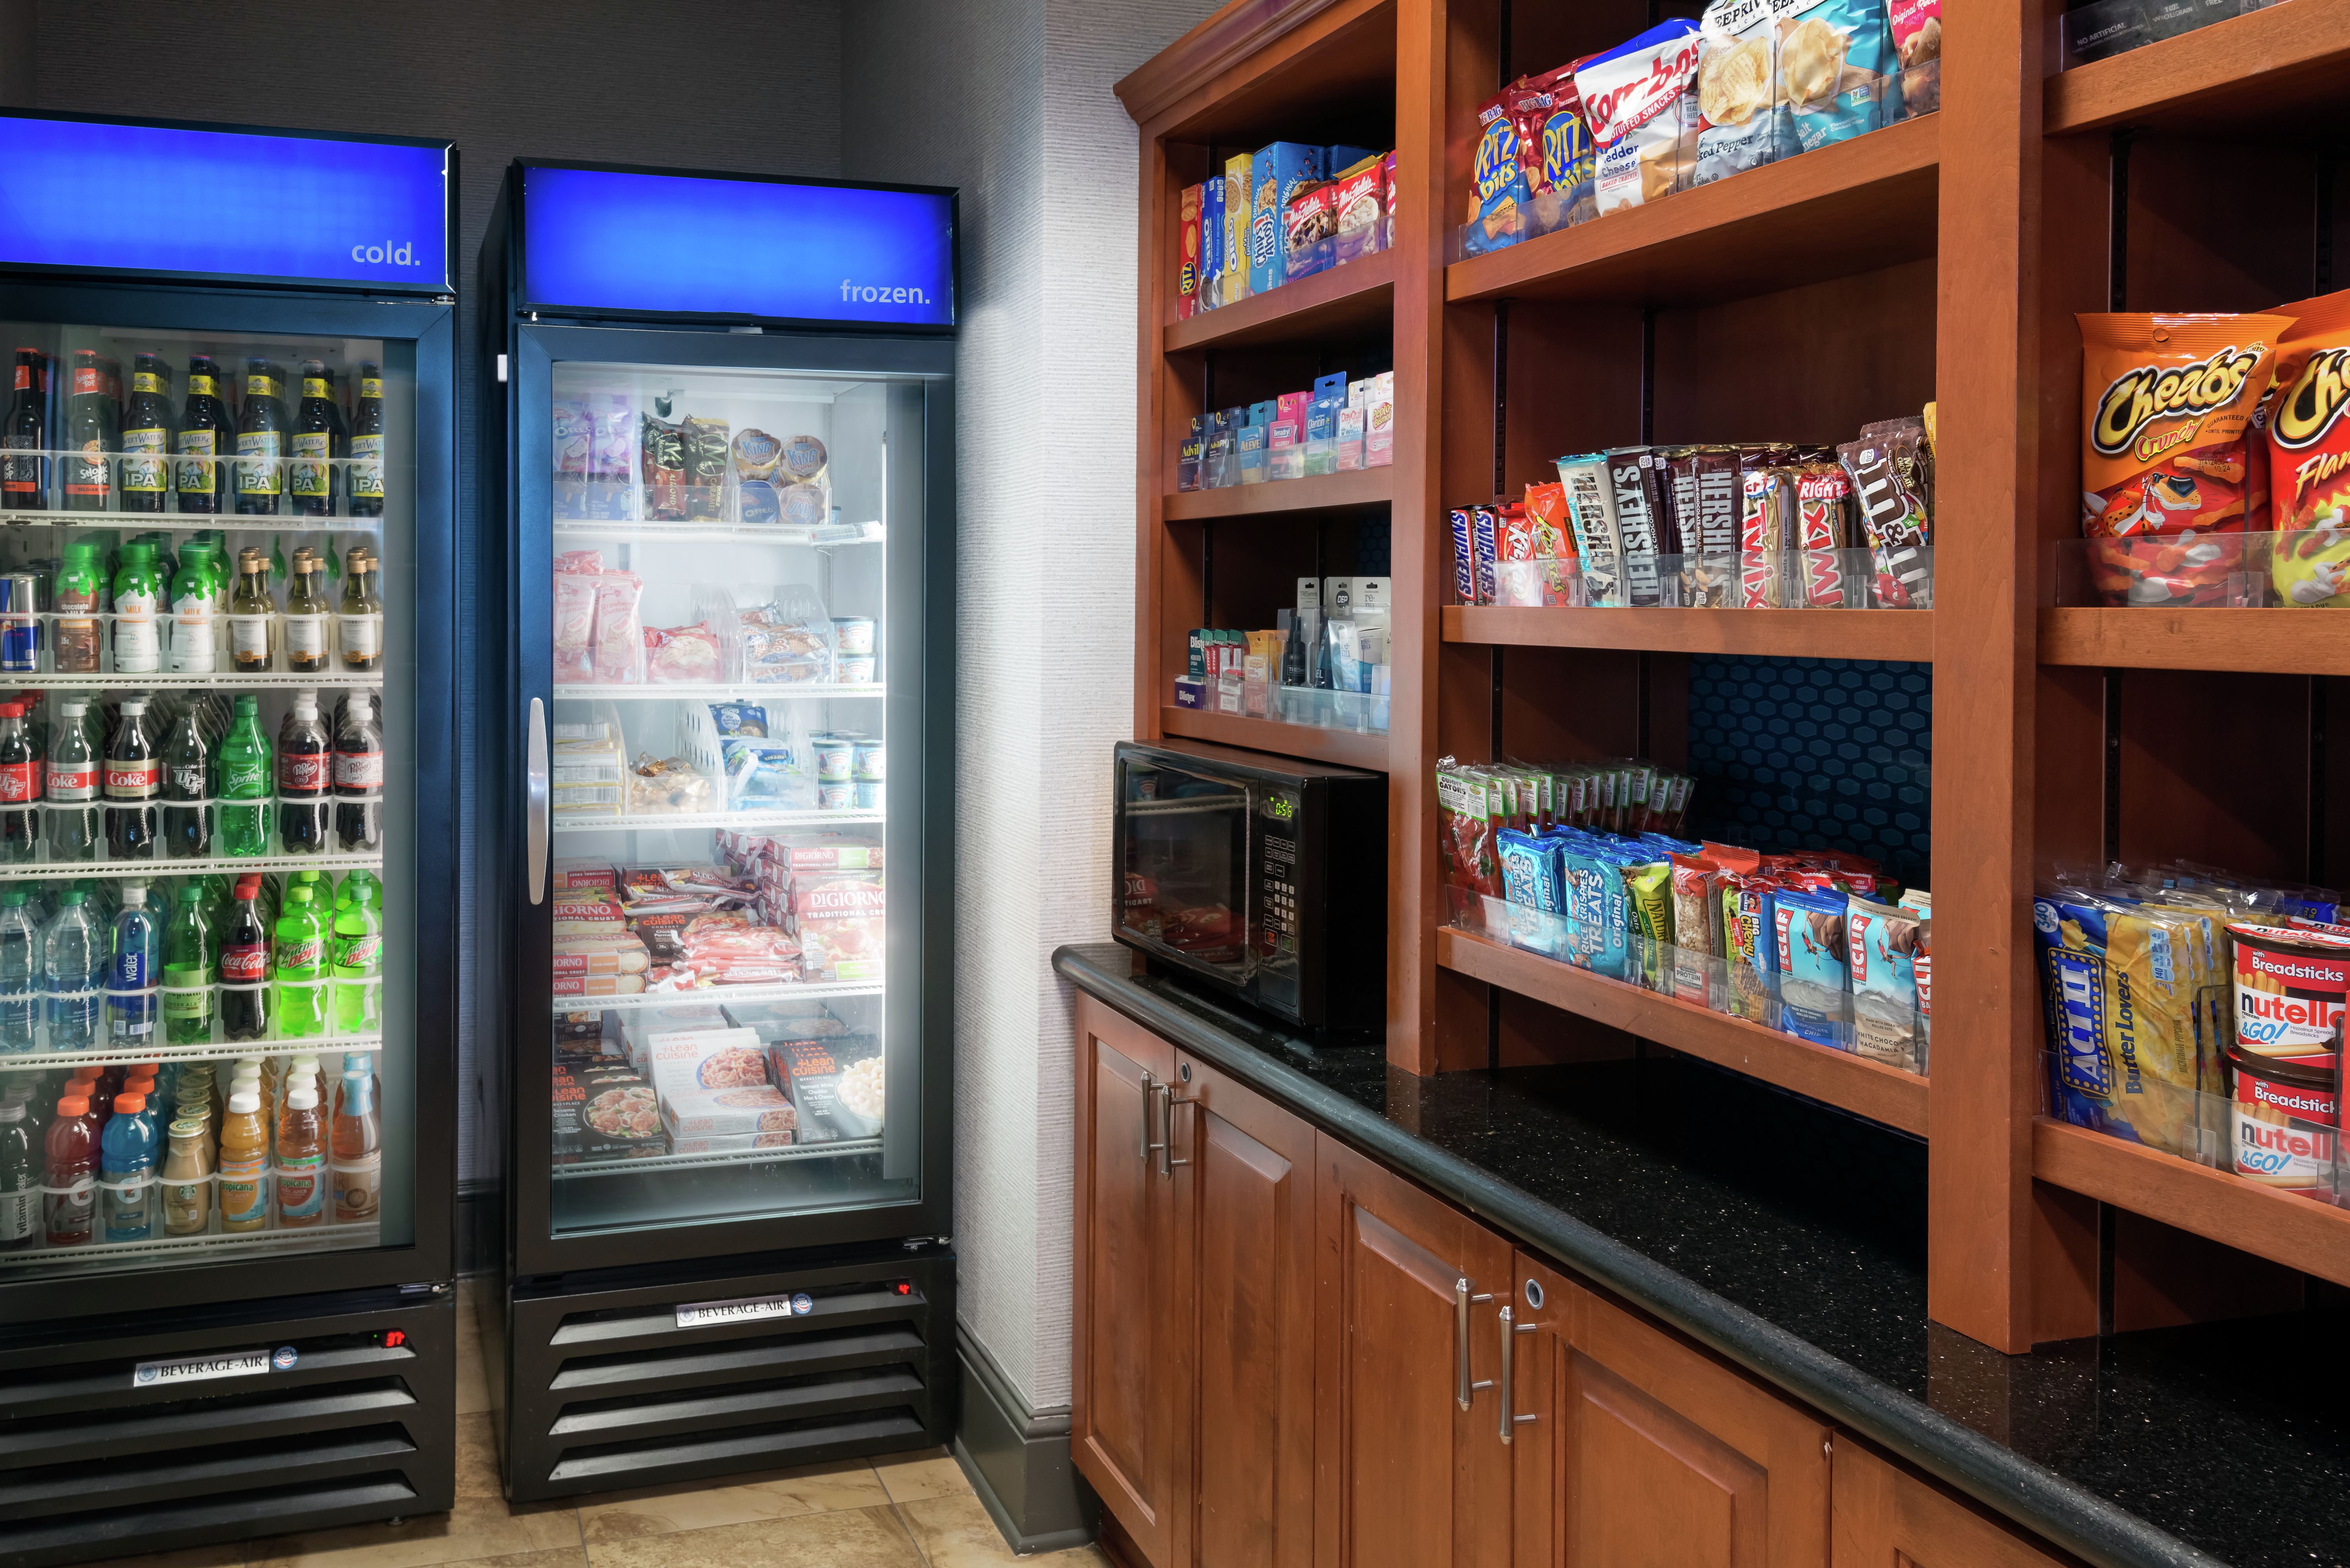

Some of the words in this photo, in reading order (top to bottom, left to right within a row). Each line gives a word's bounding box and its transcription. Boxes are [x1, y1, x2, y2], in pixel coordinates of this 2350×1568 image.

[1892, 3, 1916, 25] Original
[2165, 3, 2179, 12] 100%
[2077, 38, 2088, 46] NO
[2090, 22, 2127, 41] ARTIFICIAL
[1519, 98, 1536, 112] BIG
[1535, 93, 1553, 108] BAG
[1612, 115, 1640, 138] STUFFED
[1642, 89, 1676, 120] SNACKS
[1544, 117, 1592, 183] RITZ
[1716, 134, 1753, 154] Pepper
[1475, 124, 1519, 183] RITZ
[1602, 159, 1637, 178] Cheese
[1602, 179, 1617, 189] BAKED
[1619, 172, 1638, 185] CRACKER
[1252, 184, 1263, 218] ORIGINAL
[1229, 218, 1238, 271] OREO
[352, 241, 420, 266] cold.
[1181, 263, 1194, 293] RITZ
[840, 279, 930, 304] frozen.
[76, 373, 96, 383] SHOCK
[82, 379, 96, 387] TOP
[2094, 347, 2260, 451] Cheetos
[1308, 417, 1325, 430] Claritin
[1341, 408, 1362, 424] DayQuil
[1374, 412, 1392, 428] Bismol
[2207, 415, 2244, 428] GUARANTEED
[554, 426, 592, 437] OREO
[1273, 427, 1290, 438] Benadryl
[1240, 439, 1260, 452] ALEVE
[2135, 418, 2204, 461] Crunchy
[741, 441, 772, 456] KING
[1182, 443, 1199, 457] Advil
[786, 448, 817, 468] KING
[80, 465, 108, 479] SHOCK
[794, 463, 813, 472] Cone
[91, 474, 108, 485] TOP
[125, 473, 157, 487] IPA
[240, 476, 271, 490] IPA
[353, 479, 384, 493] IPA
[1815, 474, 1837, 483] TWO
[1799, 481, 1843, 498] RIGHT
[745, 507, 774, 517] OREO
[1567, 497, 1583, 531] COOKIES
[1614, 466, 1659, 595] HERSHEY'S
[1646, 503, 1657, 543] CHOCOLATE
[1451, 513, 1472, 596] SNICKERS
[125, 605, 142, 614] MILK
[601, 600, 634, 612] Strawberry
[603, 606, 632, 617] Shortcake
[1179, 690, 1195, 704] Blistex
[294, 764, 316, 776] Pepper
[348, 762, 370, 774] Pepper
[46, 773, 78, 788] Coke
[109, 773, 145, 786] Coke
[229, 772, 260, 786] Sprite
[1441, 777, 1462, 787] GUMMY
[1439, 782, 1466, 795] GATORS
[1276, 803, 1292, 817] 0:56
[1579, 869, 1588, 921] KRISPIES
[807, 909, 867, 919] TRADITIONAL
[1588, 874, 1604, 953] TREATS
[1631, 911, 1639, 930] Oats
[2036, 904, 2048, 929] 340
[1752, 916, 1760, 936] BIG
[1580, 925, 1591, 954] RICE
[1776, 911, 1789, 957] CLIF
[1852, 918, 1865, 966] CLIF
[221, 951, 267, 970] Coca-Cola
[1676, 970, 1701, 982] PROTEIN
[1852, 965, 1864, 975] BAR
[2252, 956, 2344, 982] Breadsticks
[2116, 972, 2134, 1032] Lovers
[2290, 1030, 2319, 1038] Breadsticks
[1860, 1040, 1899, 1053] MACADAMIA
[2065, 1009, 2100, 1081] ACT
[806, 1057, 834, 1066] Lean
[2118, 1032, 2144, 1094] Butter
[2255, 1080, 2269, 1089] with
[222, 1181, 254, 1193] Tropicana
[280, 1176, 311, 1188] Tropicana
[698, 1300, 784, 1318] BEVERAGE-AIR
[161, 1356, 263, 1377] BEVERAGE-AIR
